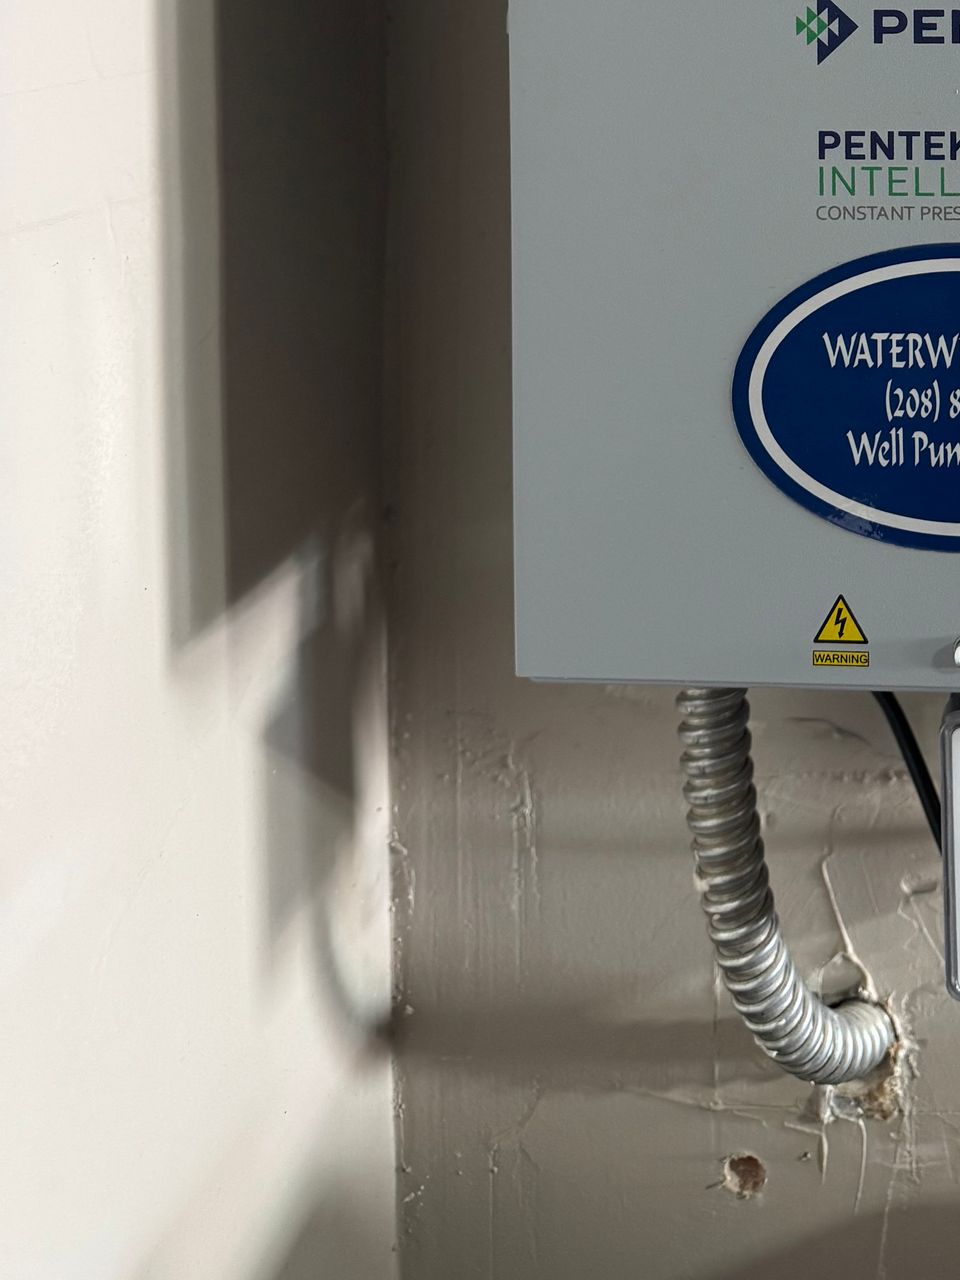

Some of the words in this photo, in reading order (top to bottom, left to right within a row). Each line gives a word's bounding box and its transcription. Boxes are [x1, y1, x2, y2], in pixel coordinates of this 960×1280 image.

[816, 206, 915, 222] CONSTANT
[885, 379, 941, 422] (208)
[846, 427, 904, 468] Well
[814, 653, 869, 665] WARNING
